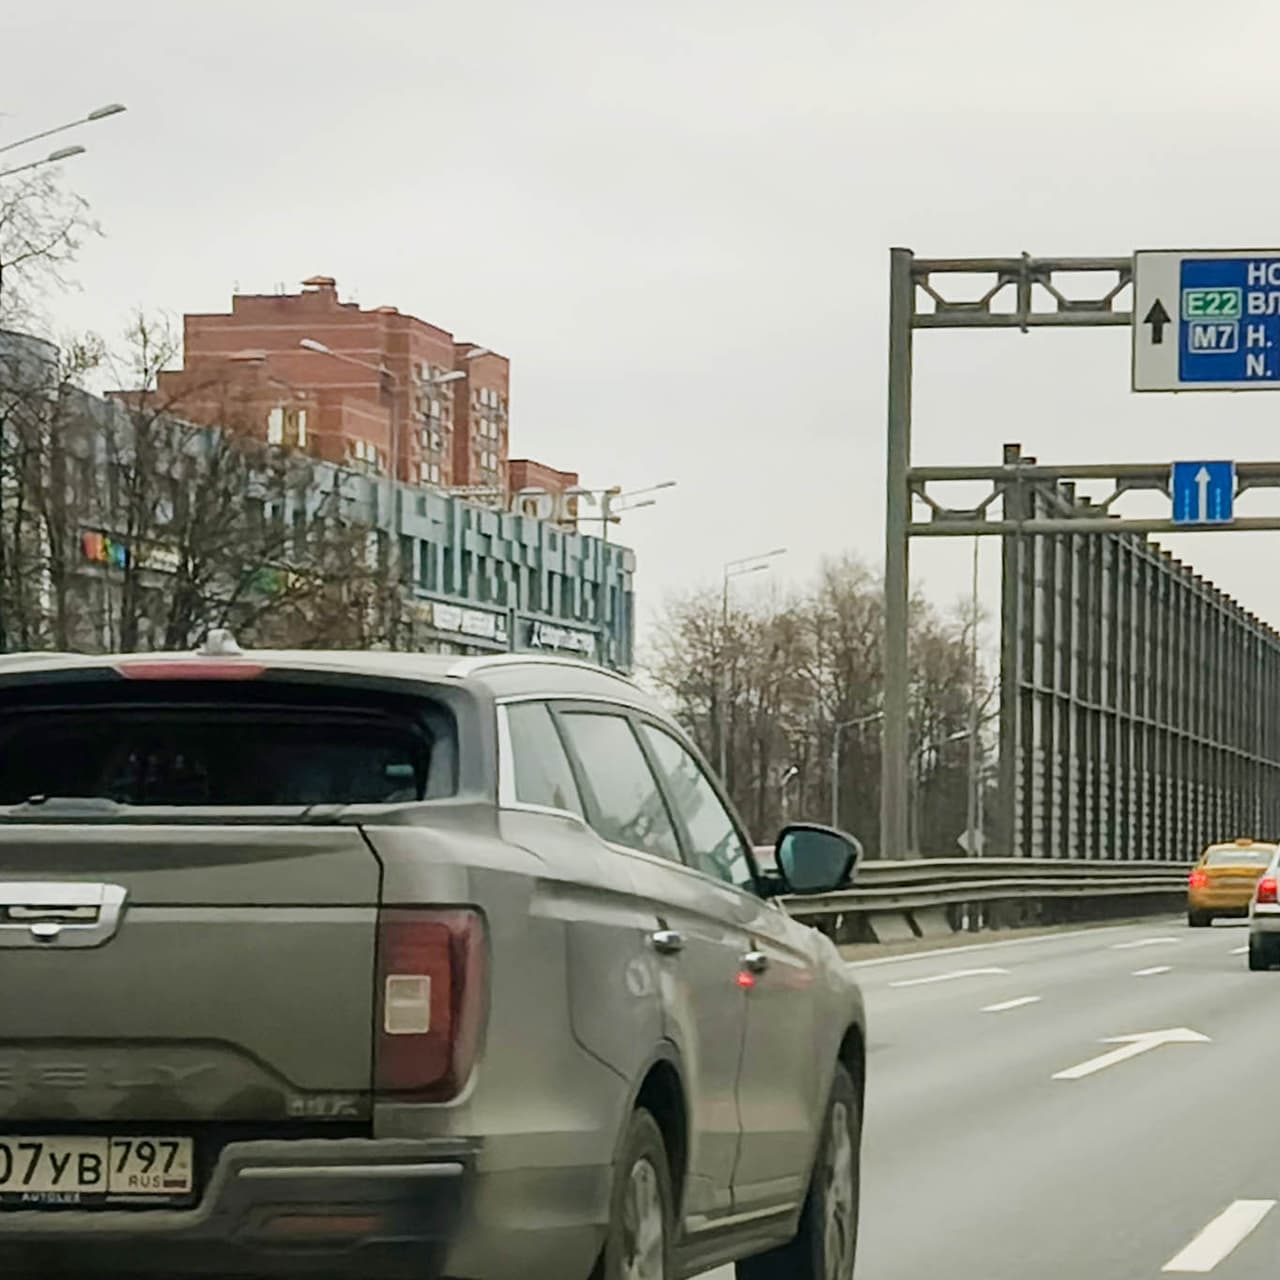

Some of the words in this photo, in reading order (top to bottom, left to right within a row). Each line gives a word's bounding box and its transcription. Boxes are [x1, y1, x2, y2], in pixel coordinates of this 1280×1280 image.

[1187, 294, 1238, 316] E22
[1193, 325, 1233, 349] М7
[1246, 325, 1273, 347] Н.
[1246, 354, 1273, 377] N.
[113, 1141, 180, 1173] 797
[129, 1175, 161, 1188] RUS
